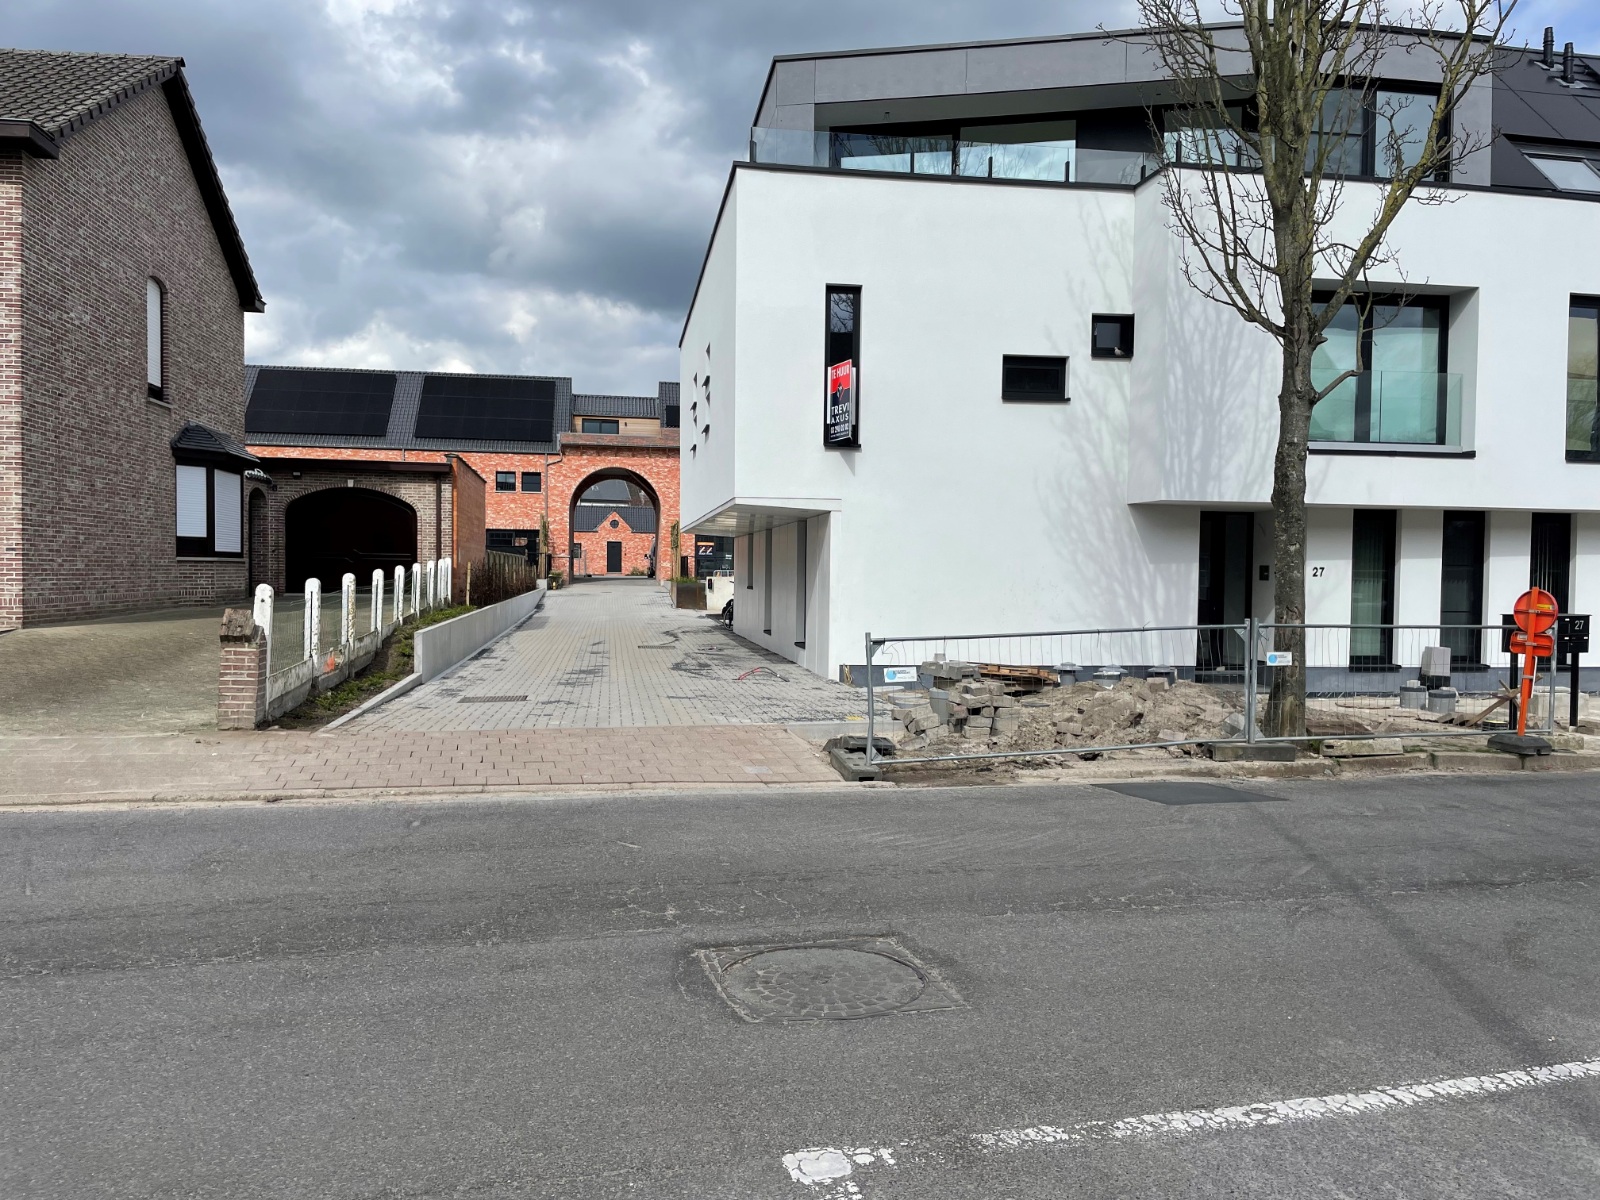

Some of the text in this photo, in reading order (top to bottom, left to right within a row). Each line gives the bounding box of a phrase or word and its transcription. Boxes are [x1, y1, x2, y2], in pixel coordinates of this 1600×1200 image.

[831, 364, 849, 380] TE HUUR
[831, 402, 849, 415] TREVI
[831, 413, 849, 424] AXUS
[1312, 567, 1325, 577] 27
[1574, 620, 1584, 630] 27
